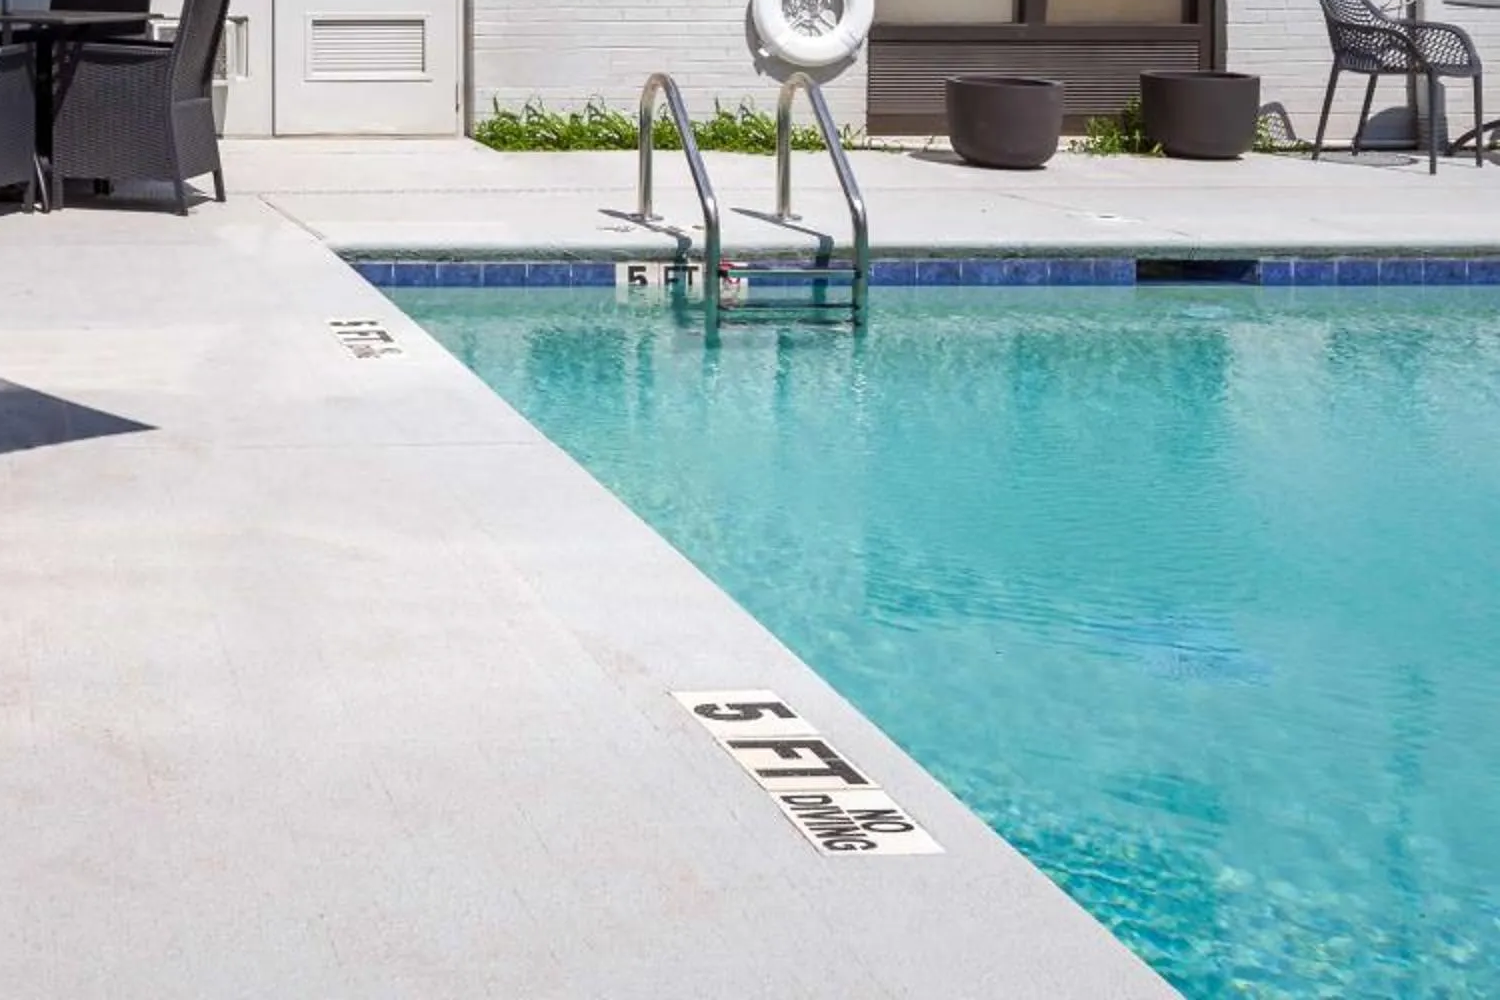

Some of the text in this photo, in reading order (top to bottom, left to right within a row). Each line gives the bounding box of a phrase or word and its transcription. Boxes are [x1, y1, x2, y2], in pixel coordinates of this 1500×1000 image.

[628, 266, 648, 286] 5
[694, 702, 869, 785] 5 FT
[779, 794, 878, 851] DIVING
[846, 809, 915, 833] NO
